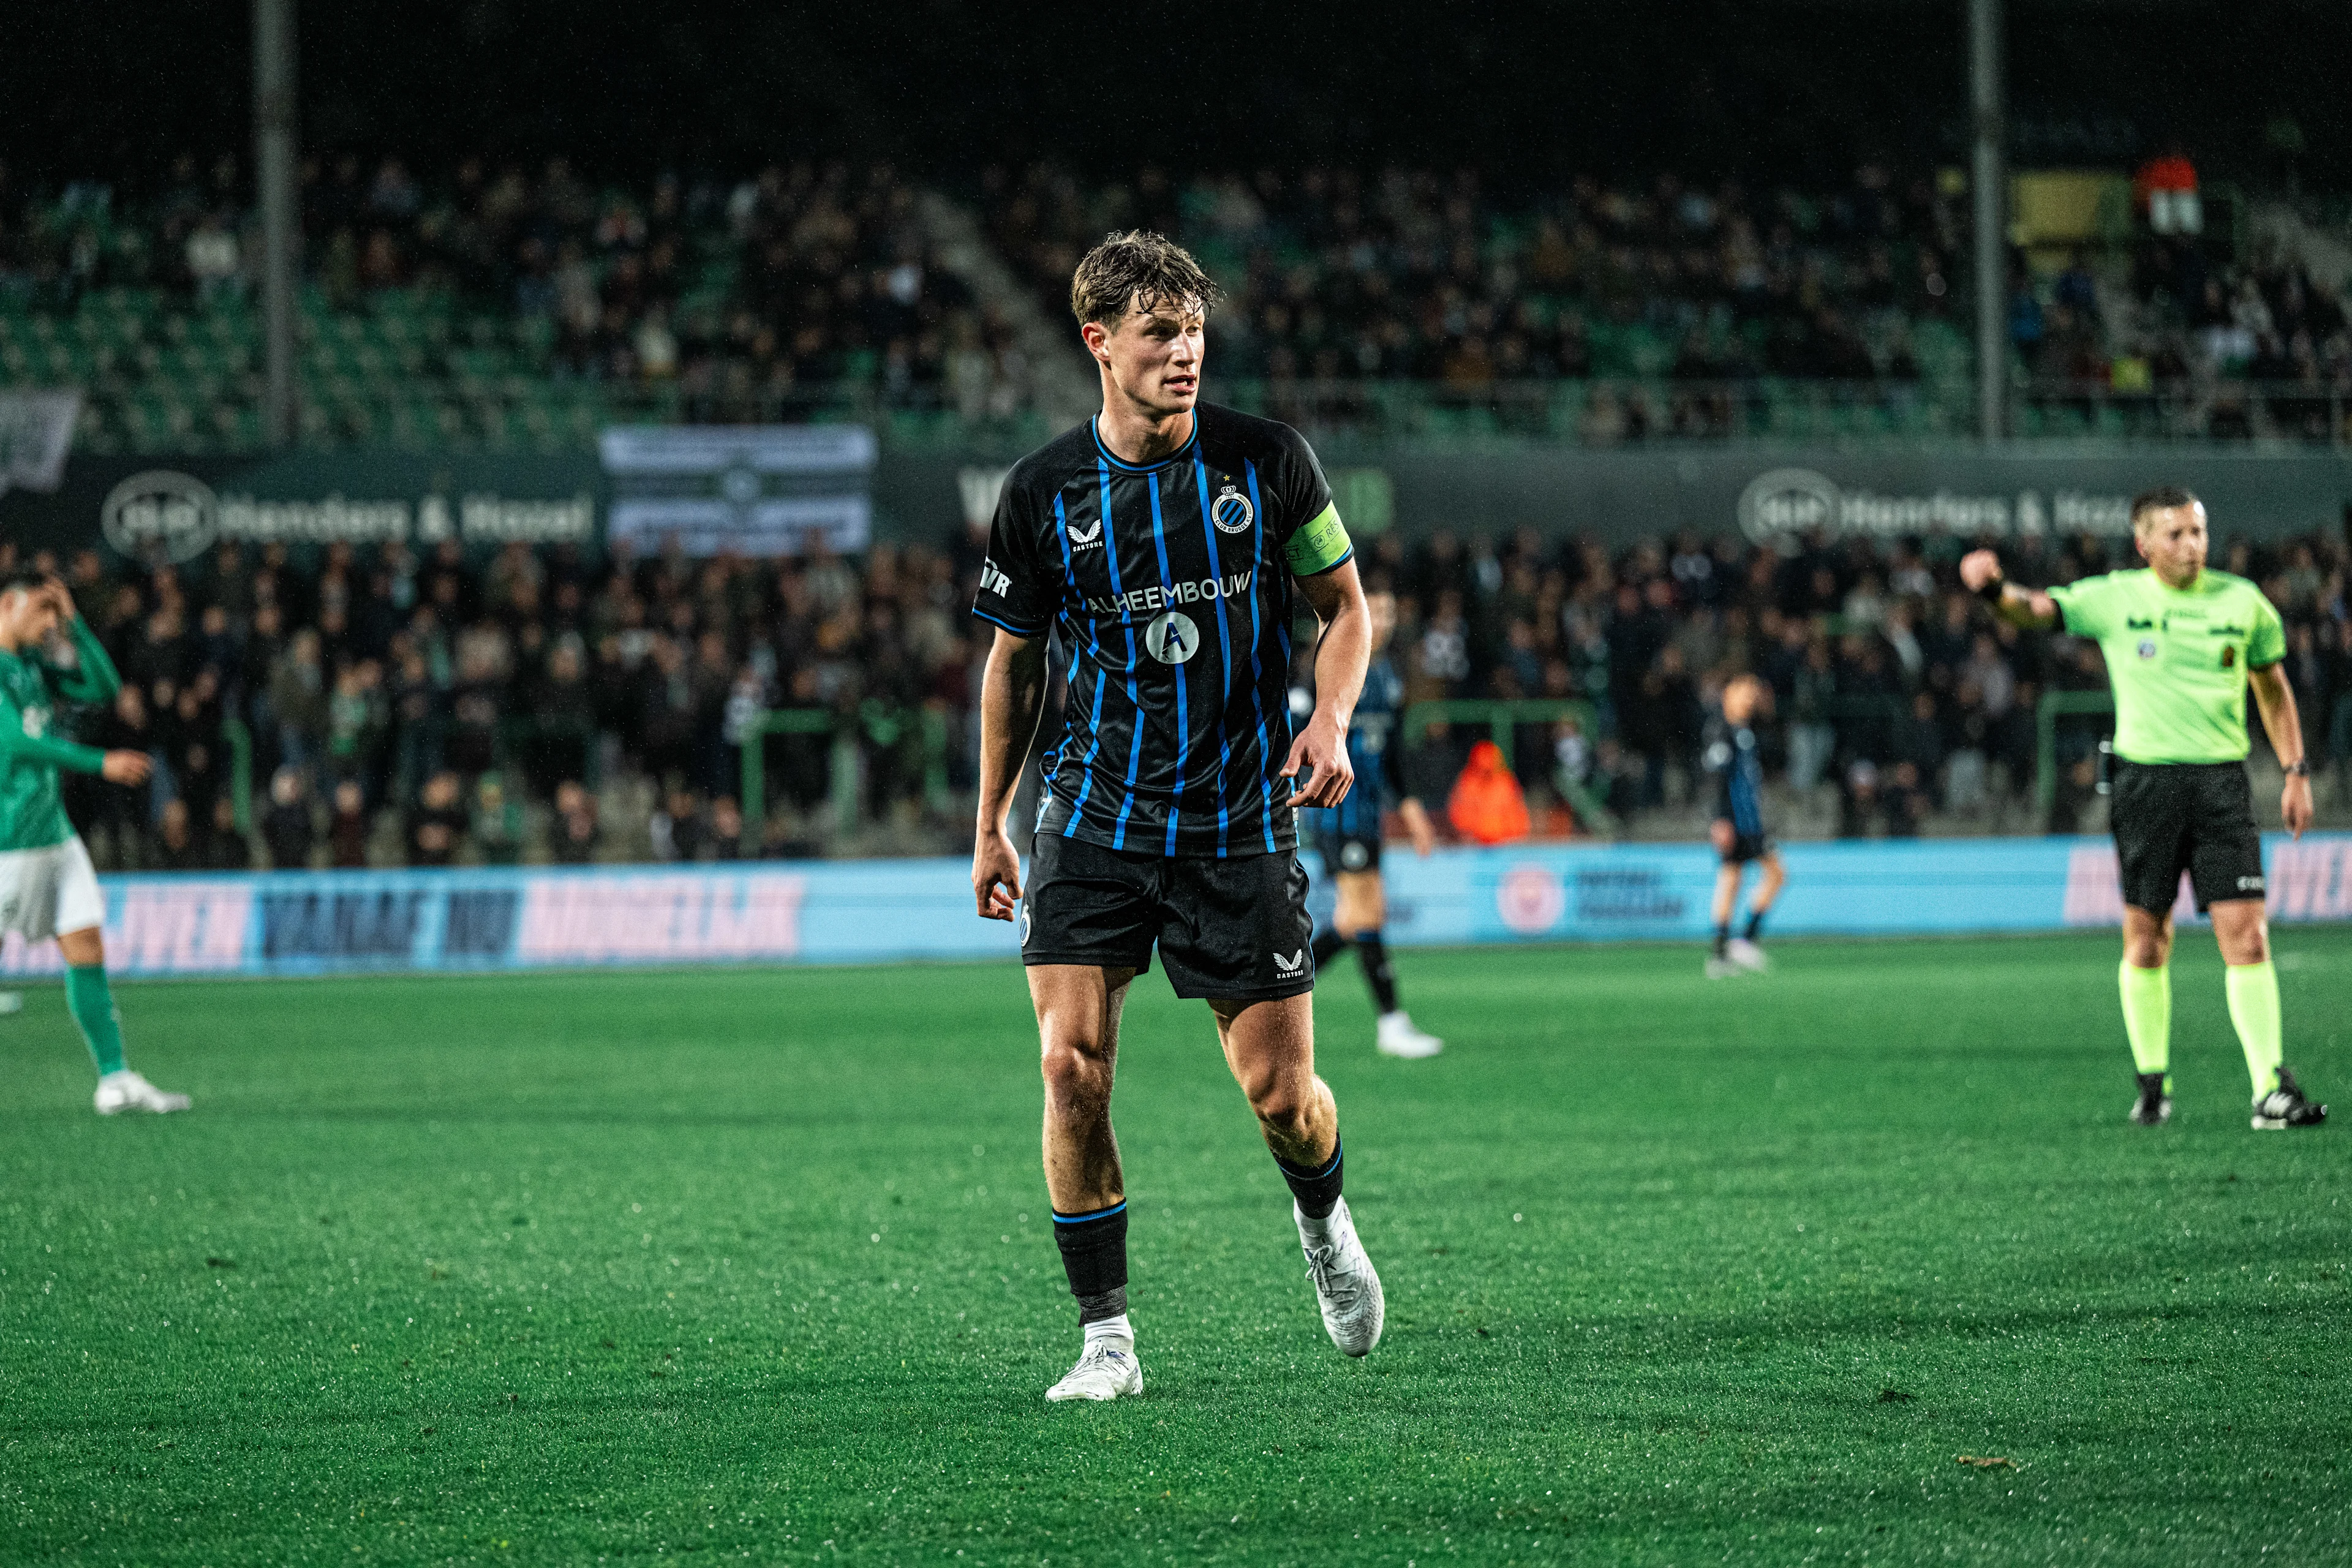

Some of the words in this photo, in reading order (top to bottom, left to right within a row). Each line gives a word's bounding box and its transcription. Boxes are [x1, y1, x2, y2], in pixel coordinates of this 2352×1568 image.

[1215, 519, 1227, 530] CLUB
[1227, 522, 1248, 532] BRUGGE
[1073, 541, 1103, 552] CASTORE
[1088, 571, 1251, 613] ALHEEMBOUW
